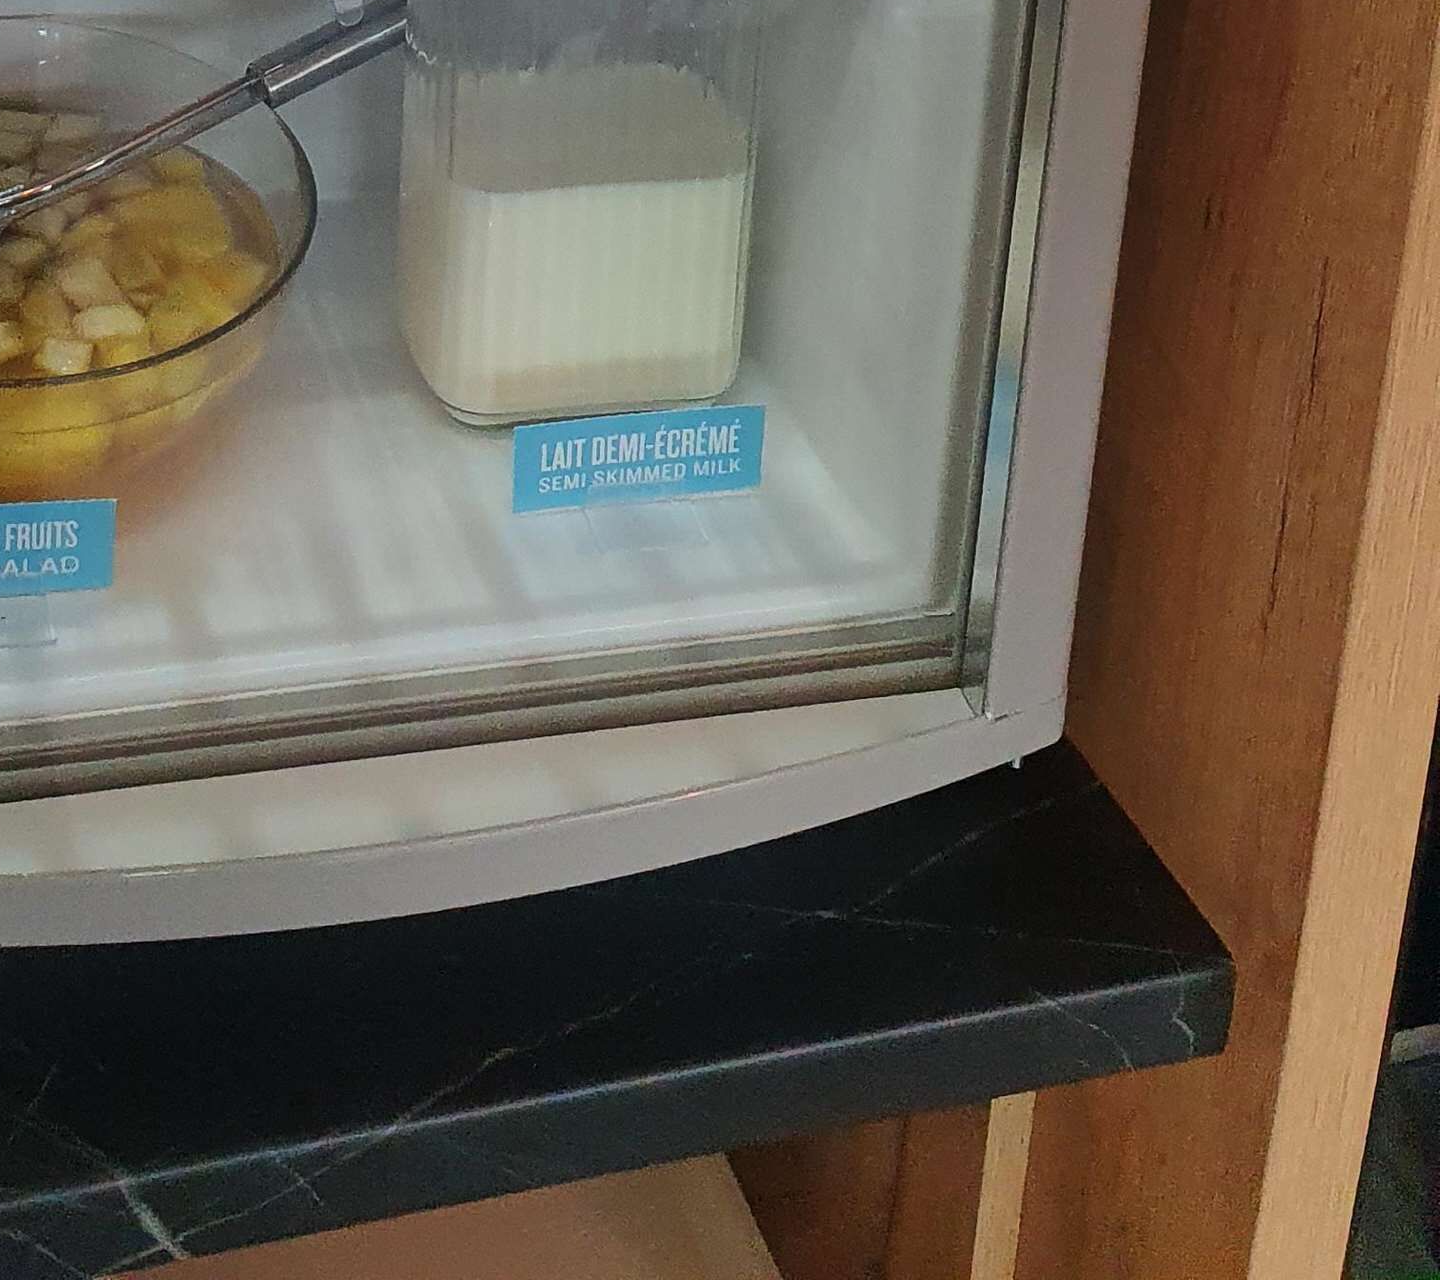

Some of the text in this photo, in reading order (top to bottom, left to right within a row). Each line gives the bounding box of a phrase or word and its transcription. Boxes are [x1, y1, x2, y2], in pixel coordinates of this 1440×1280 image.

[540, 418, 742, 473] LAIT DEMI-ÉCRÉMÉ
[538, 457, 742, 494] SEMI SKIMMED MILK
[4, 519, 79, 551] FRUITS
